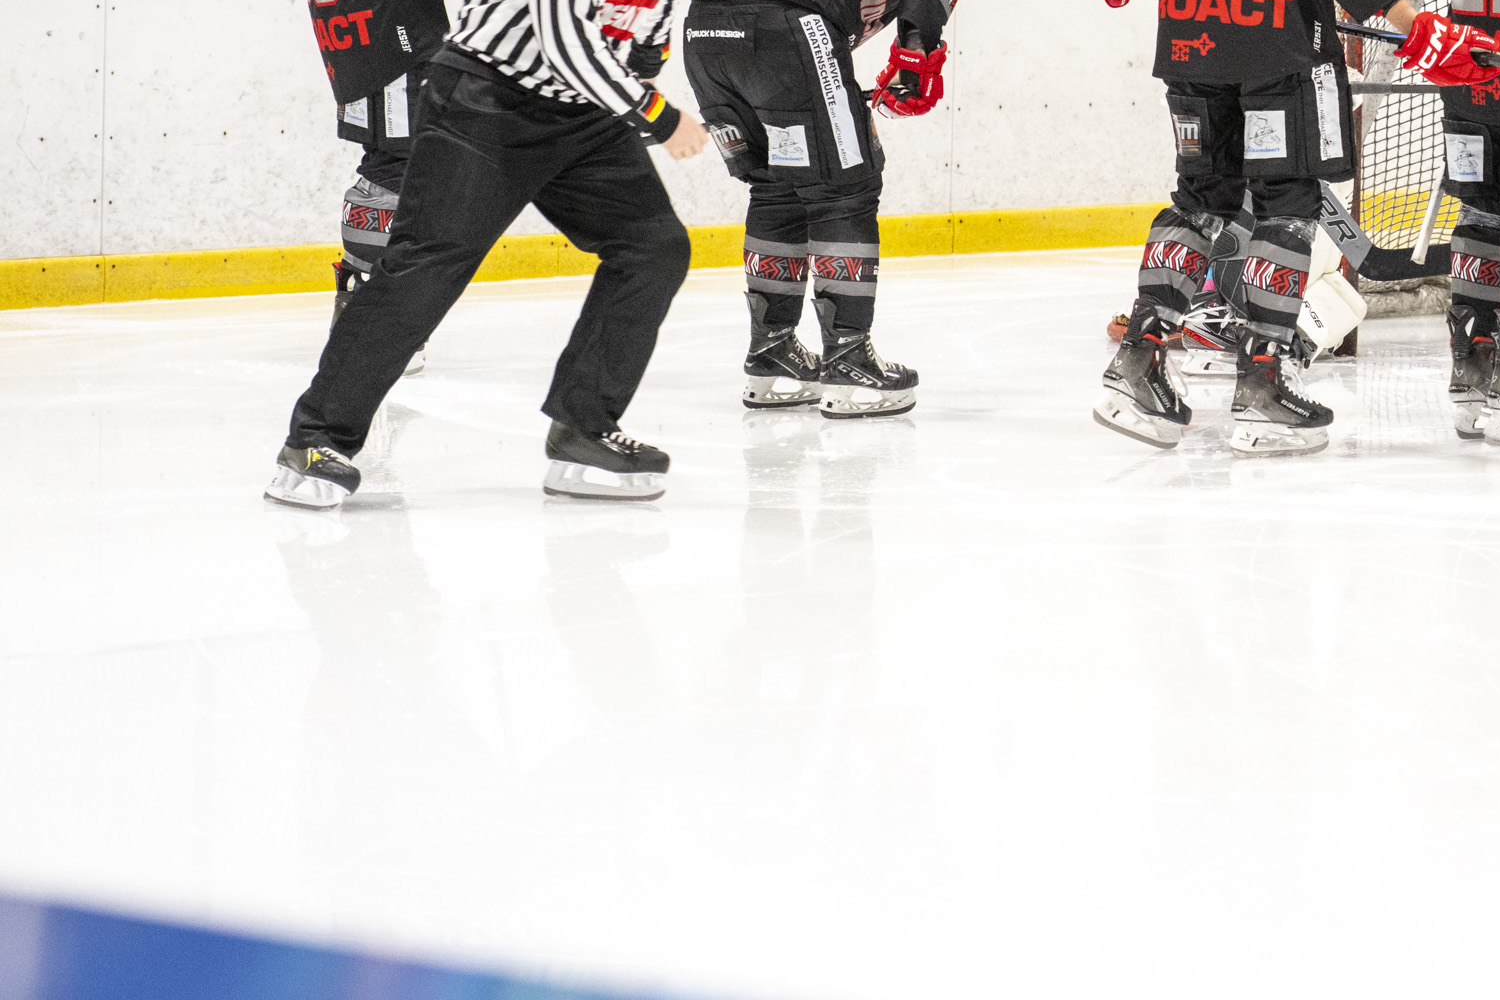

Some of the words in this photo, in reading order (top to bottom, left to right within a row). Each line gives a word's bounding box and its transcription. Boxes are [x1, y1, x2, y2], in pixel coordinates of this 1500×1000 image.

[715, 30, 745, 39] DESIGN
[803, 20, 837, 108] STRATENSCHULTE
[899, 54, 920, 63] CCM
[837, 363, 874, 386] CCM
[1152, 382, 1172, 408] BAUER
[1280, 399, 1311, 418] BAUER
